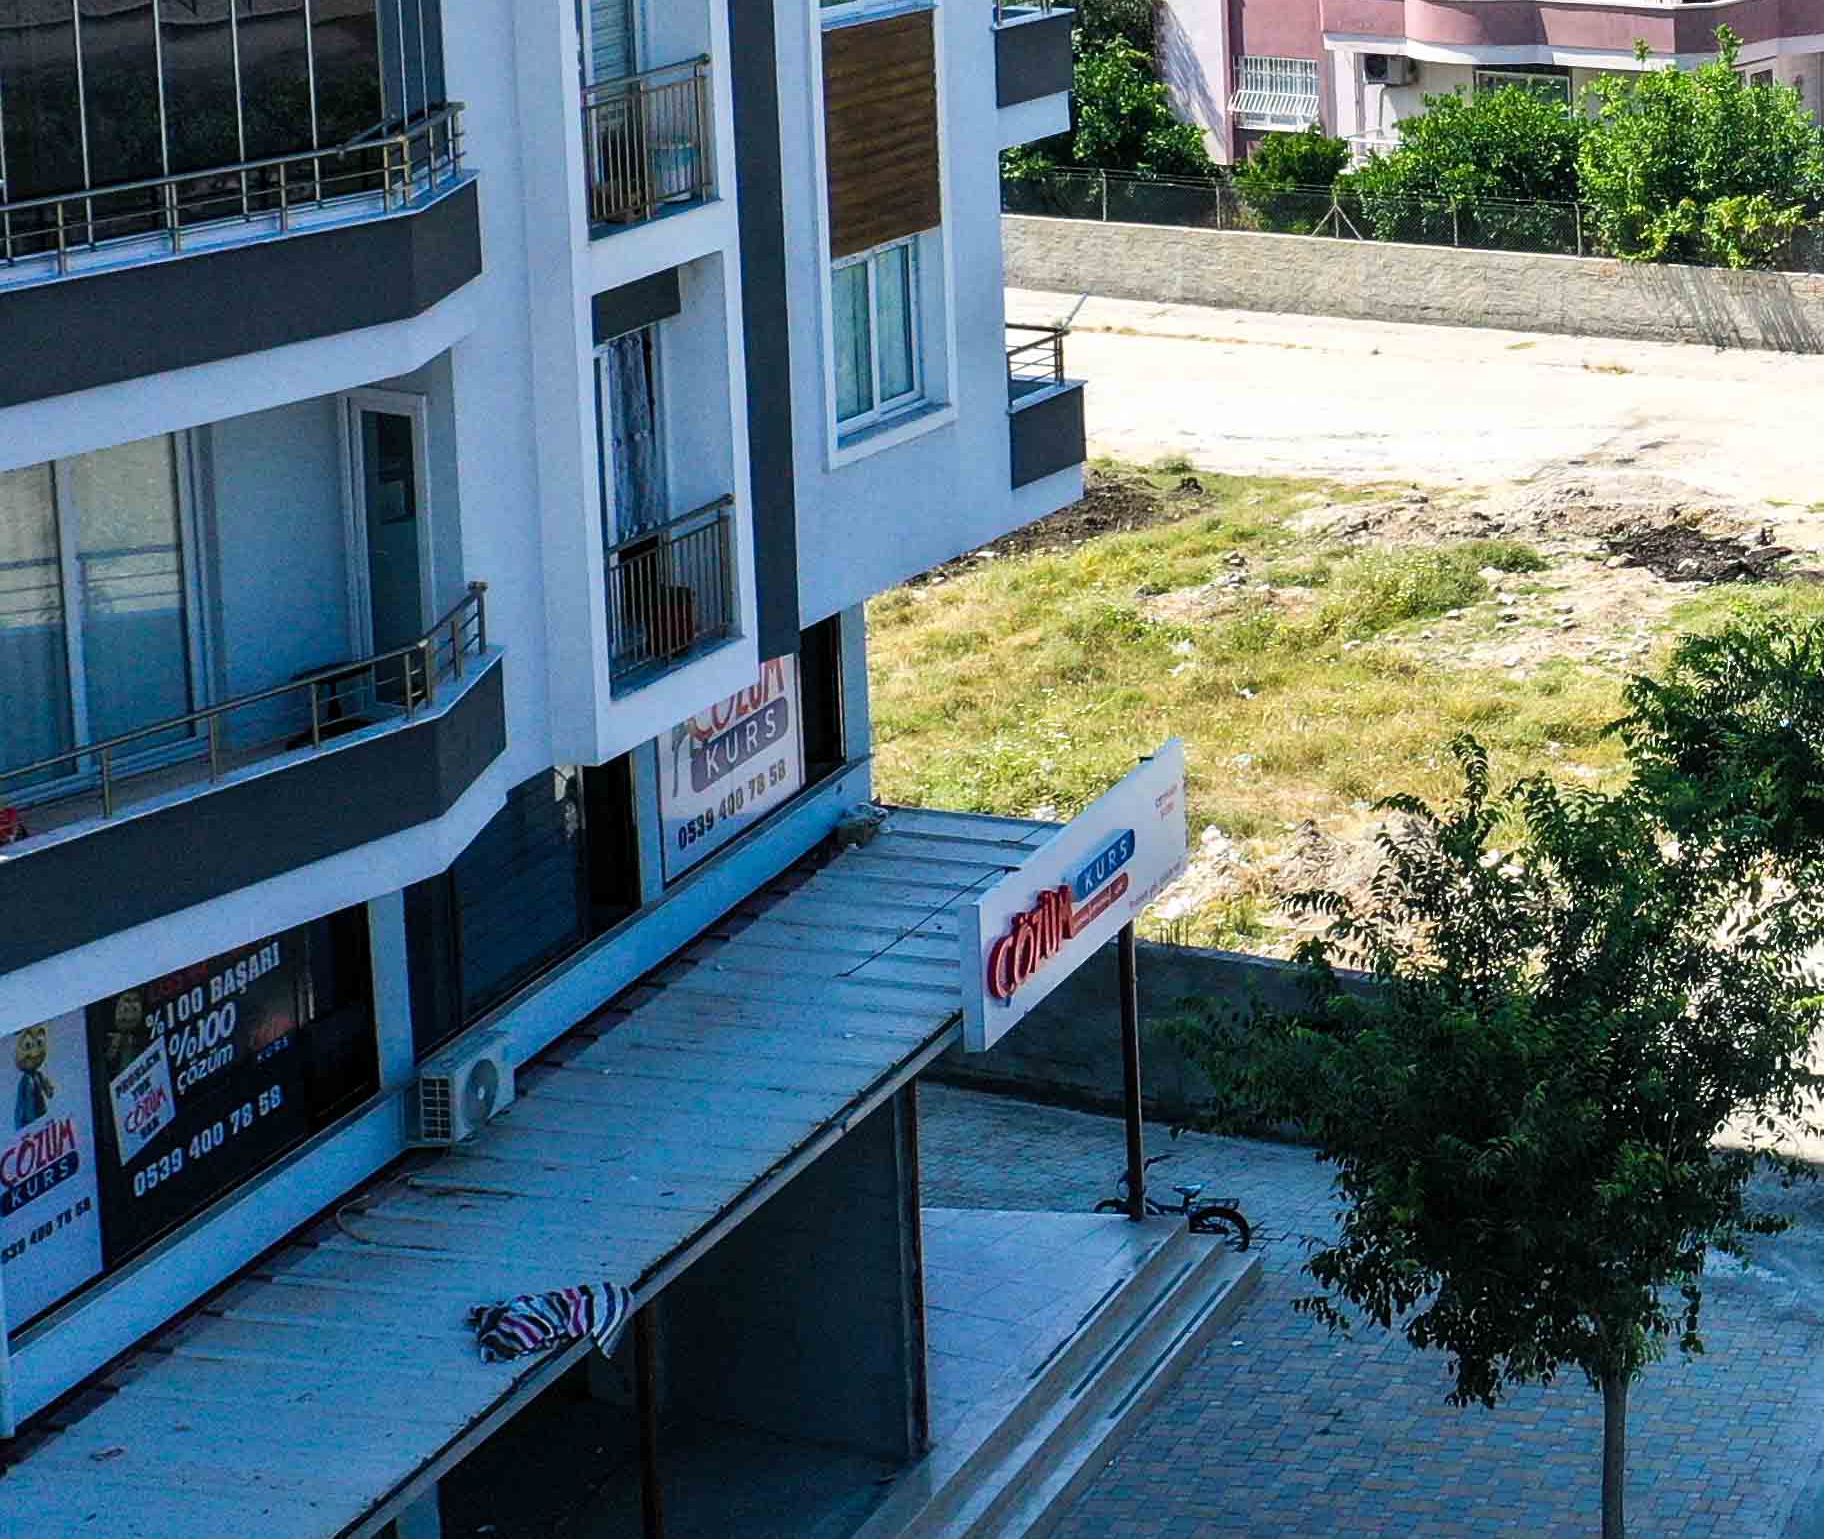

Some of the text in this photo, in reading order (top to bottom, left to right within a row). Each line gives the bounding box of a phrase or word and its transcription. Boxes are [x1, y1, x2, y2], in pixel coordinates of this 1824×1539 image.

[706, 708, 777, 780] KURS
[678, 807, 714, 850] 0539
[719, 786, 744, 821] 400
[749, 772, 766, 800] 78
[1084, 838, 1128, 892] KURS
[145, 986, 203, 1040] %100
[209, 941, 281, 1003] BAŞARI
[168, 1001, 236, 1067] %100
[10, 1157, 70, 1208] KURS
[133, 1147, 184, 1197] 0539
[188, 1121, 225, 1160] 400
[229, 1102, 254, 1135] 78
